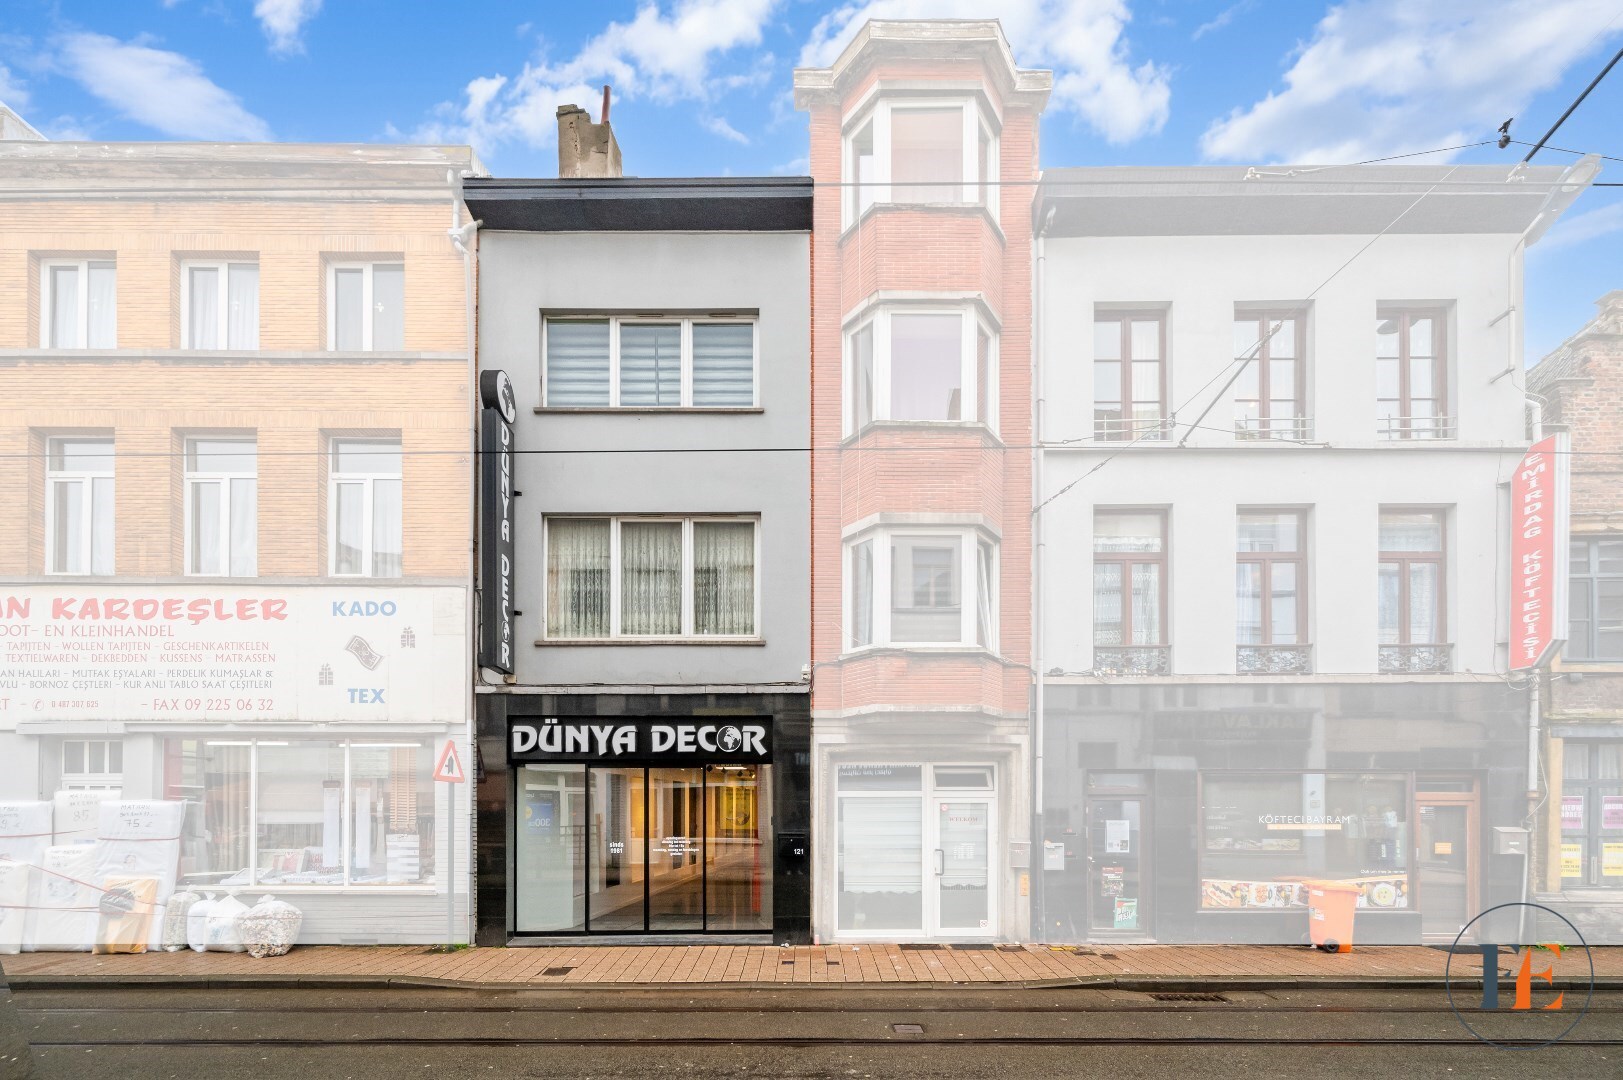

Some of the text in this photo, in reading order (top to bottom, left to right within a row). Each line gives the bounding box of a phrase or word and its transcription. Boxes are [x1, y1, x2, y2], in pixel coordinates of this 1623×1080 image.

[501, 420, 510, 543] DÜNYA
[0, 597, 289, 626] N KARDEŞLER
[332, 600, 397, 617] KADO
[44, 624, 65, 638] EN
[71, 624, 175, 638] KLEINHANDEL
[7, 641, 269, 653] TAPIJTEN WOLLEN TAPIJTEN GESCHENKARTIKELEN
[6, 653, 277, 663] TEXTIELWAREN DEKBEDDEN KUSSENS MATRASSEN
[18, 669, 61, 679] HALILARI
[72, 669, 111, 679] MUTFAK
[210, 669, 262, 681] KUMAŞLAR
[29, 680, 69, 690] BORNOZ
[170, 680, 199, 690] TABLO
[202, 680, 227, 690] SAAT
[347, 688, 386, 704] TEX
[153, 698, 180, 712] FAX
[184, 698, 202, 712] 09
[206, 698, 231, 712] 225
[236, 698, 253, 712] 06
[257, 698, 274, 712] 32
[512, 718, 768, 757] DÜNYA DECOR
